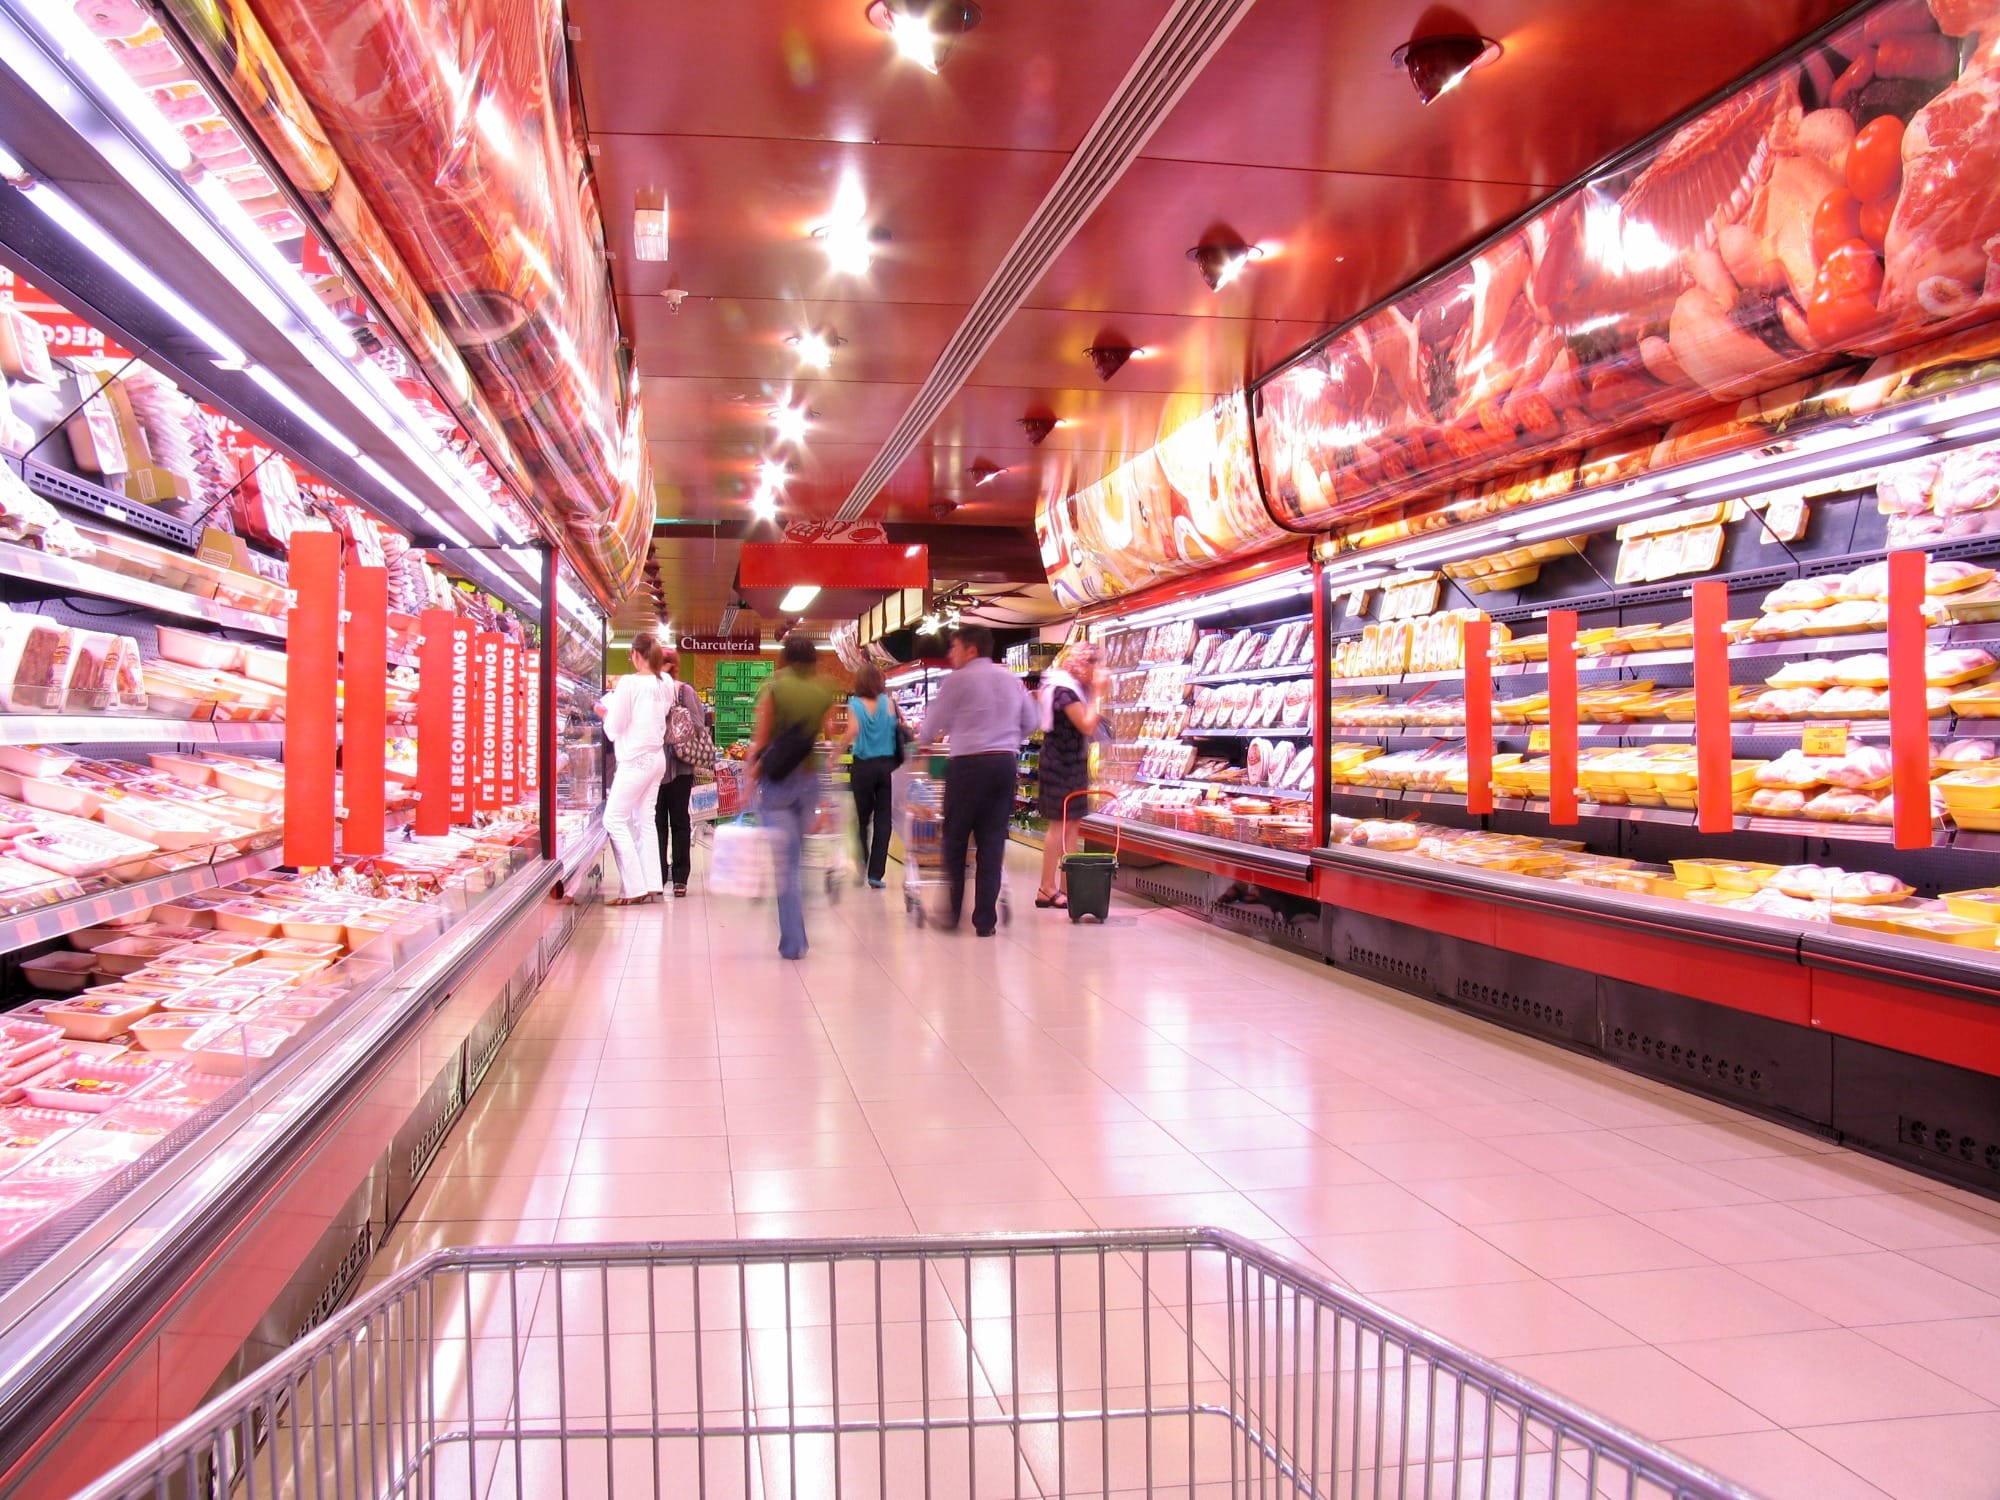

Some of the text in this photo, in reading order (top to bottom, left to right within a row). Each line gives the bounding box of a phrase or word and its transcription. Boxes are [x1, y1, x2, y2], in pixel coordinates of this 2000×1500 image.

[680, 636, 754, 651] Charcutería
[451, 630, 467, 812] LE RECOMENDAMOS
